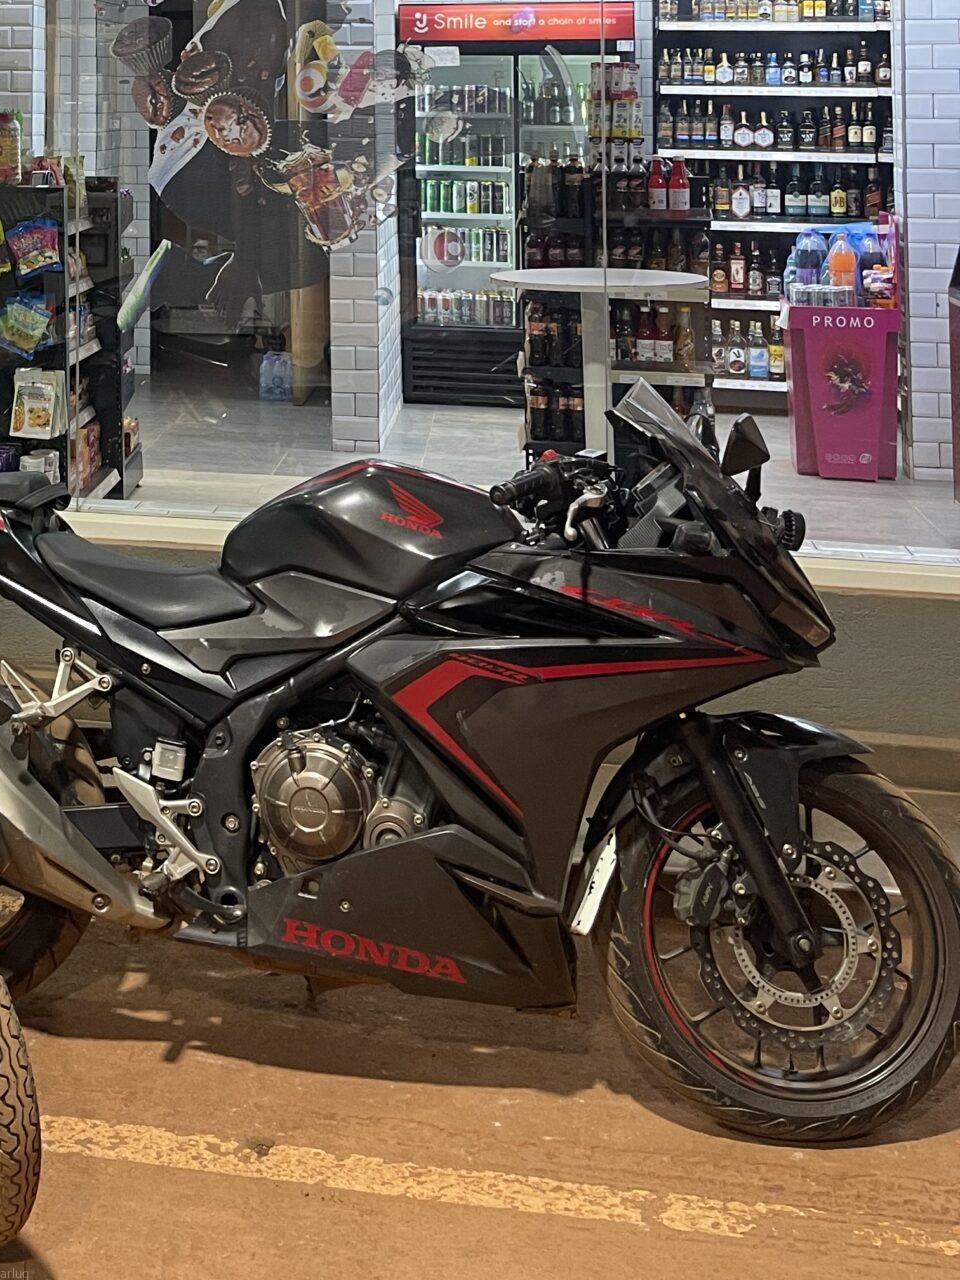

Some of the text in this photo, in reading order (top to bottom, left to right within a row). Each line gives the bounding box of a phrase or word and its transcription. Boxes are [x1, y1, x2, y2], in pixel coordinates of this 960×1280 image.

[434, 13, 487, 30] Smile
[493, 18, 511, 26] and
[547, 16, 573, 25] chain
[576, 16, 586, 25] of
[812, 315, 874, 328] PROMO
[380, 511, 444, 540] HONDA
[280, 917, 468, 985] HONDA
